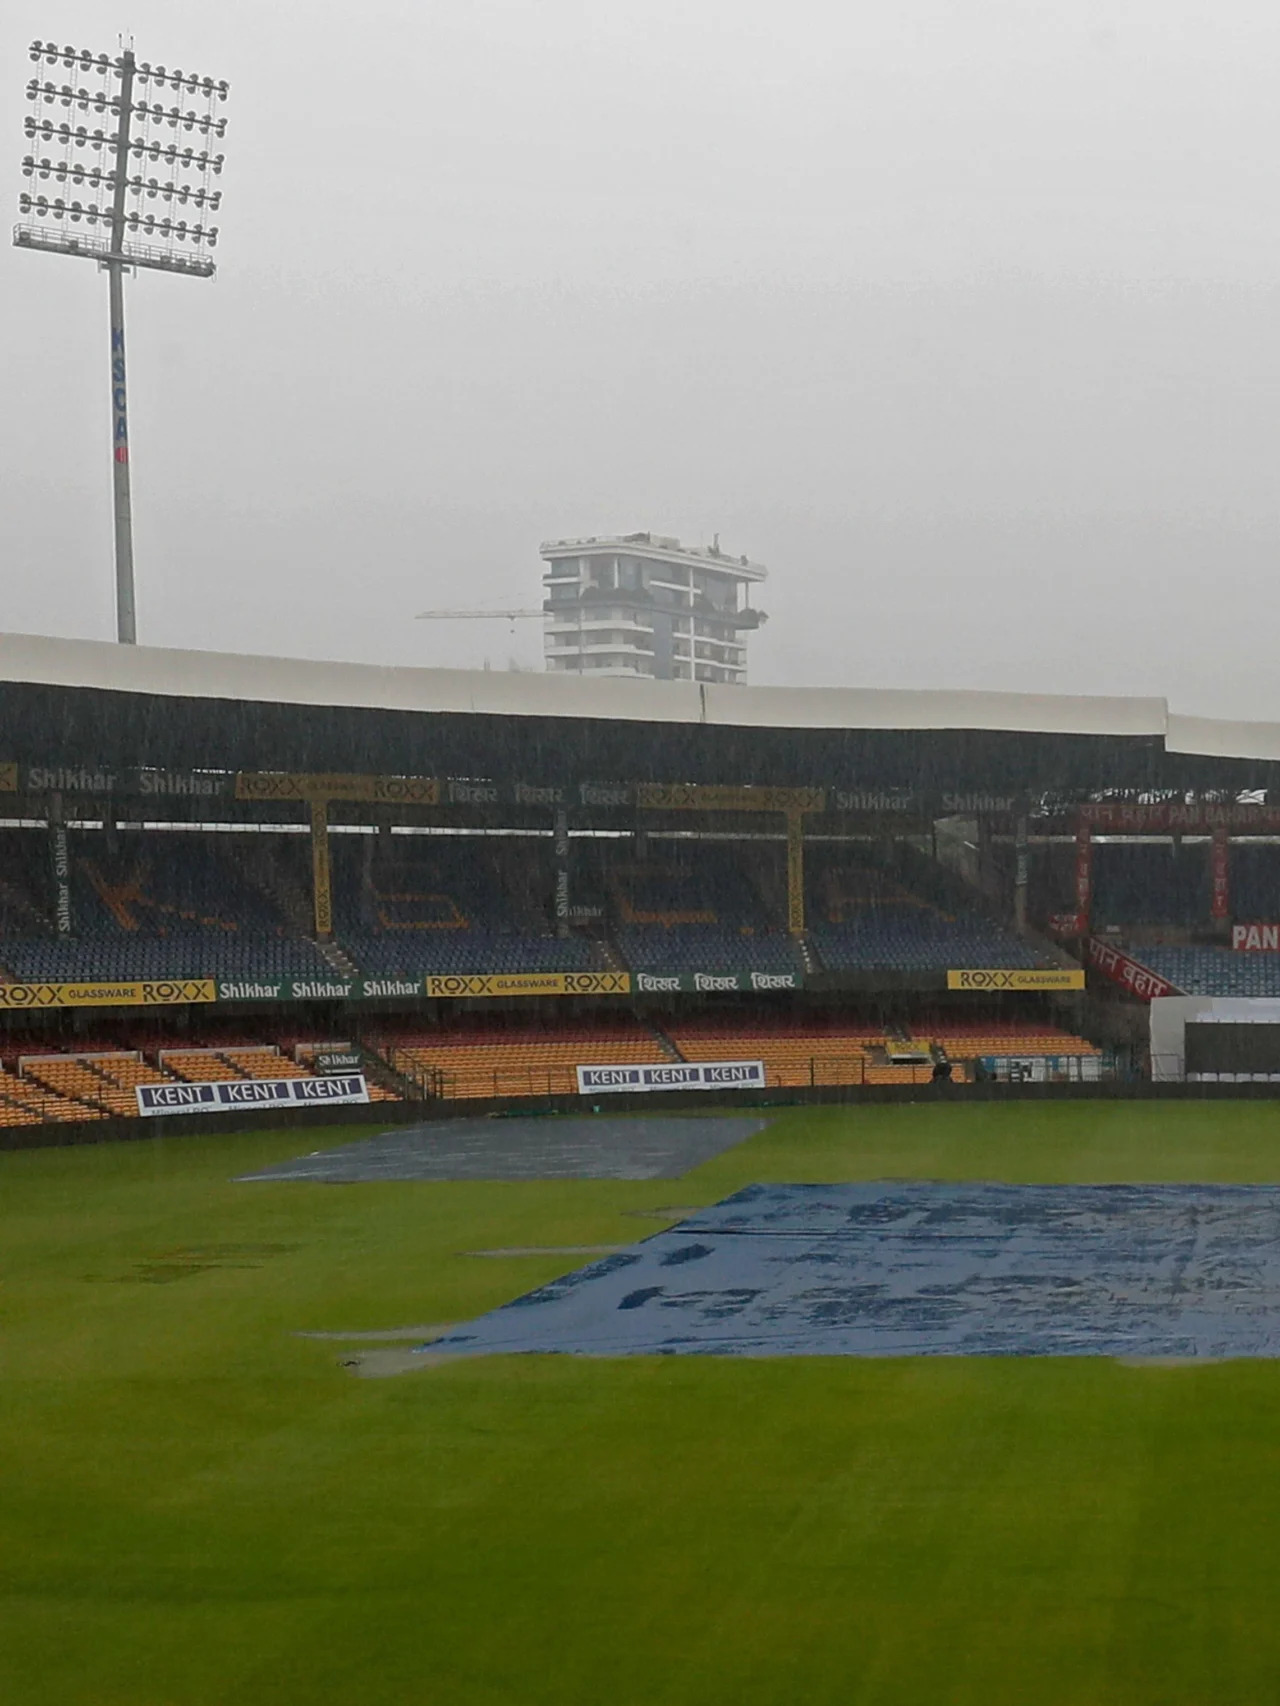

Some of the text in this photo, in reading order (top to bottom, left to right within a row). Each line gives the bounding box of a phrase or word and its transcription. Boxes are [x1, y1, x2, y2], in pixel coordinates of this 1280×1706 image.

[28, 767, 118, 790] Shikhar
[139, 772, 224, 796] Shikhar
[239, 777, 300, 795] ROXX
[373, 780, 435, 800] ROXX
[836, 791, 1015, 811] Shikhar Shikhar
[55, 828, 70, 933] Shikhar Shikhar
[1232, 924, 1279, 950] PAN
[219, 979, 421, 999] Shikhar Shikhar Shikhar
[431, 974, 625, 995] ROXX GLASSWARE ROXX
[960, 971, 1071, 988] ROXX GLASSWARE
[0, 982, 209, 1006] ROXX GLASSWARE ROXX
[318, 1053, 360, 1066] Shikhar
[590, 1071, 632, 1085] KENT
[650, 1069, 692, 1083] KENT
[711, 1066, 751, 1081] KENT
[151, 1086, 203, 1105] KENT
[227, 1083, 278, 1101] KENT
[301, 1079, 352, 1097] KENT
